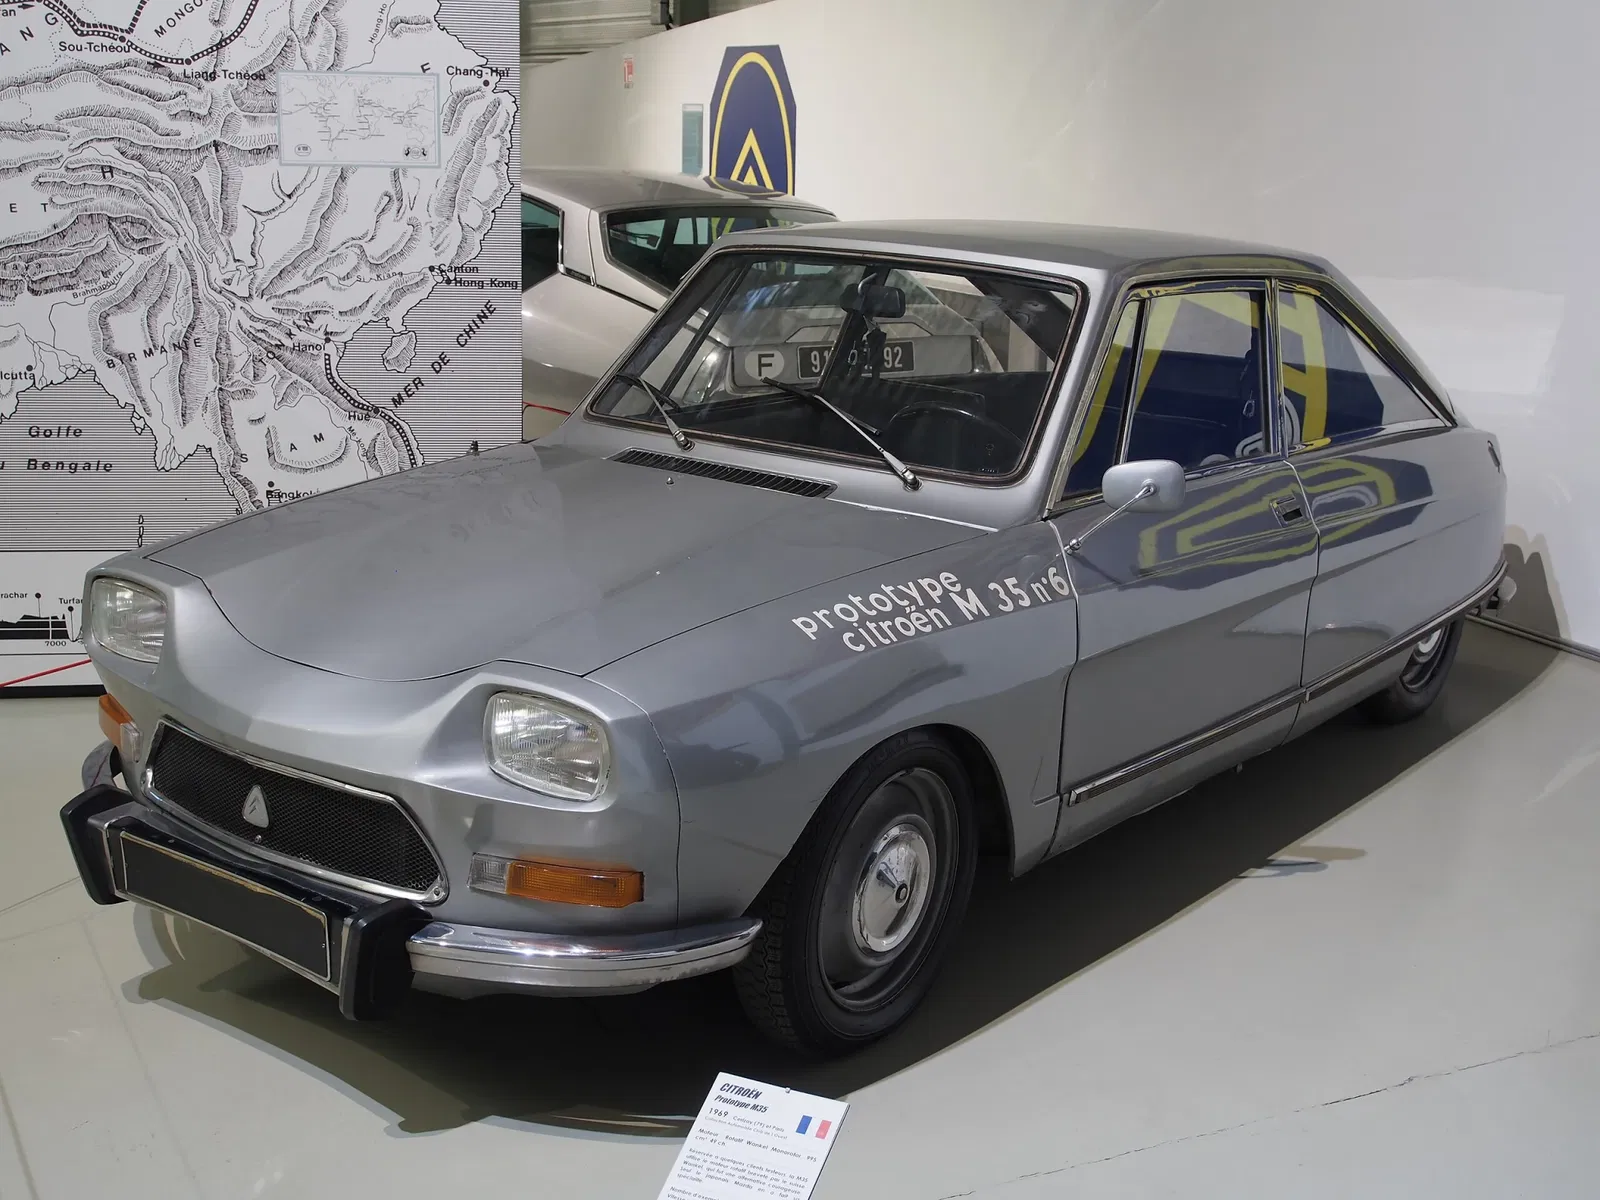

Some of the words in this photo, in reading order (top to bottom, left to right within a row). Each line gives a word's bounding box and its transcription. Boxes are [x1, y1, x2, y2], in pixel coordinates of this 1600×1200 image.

[368, 3, 387, 43] Hoang-Ho
[59, 41, 130, 53] Sou-Tchéou
[439, 264, 479, 273] Canton
[454, 278, 518, 290] Hong-Kong
[391, 377, 424, 408] MER
[431, 351, 450, 374] DE
[456, 299, 496, 348] CHINE
[883, 346, 903, 368] 92
[758, 353, 775, 377] F
[28, 425, 83, 438] Golfe
[27, 458, 113, 473] Bengale
[791, 571, 962, 640] prototype
[842, 607, 952, 652] citroën
[949, 588, 989, 620] M
[988, 577, 1031, 612] 35
[720, 1083, 763, 1100] CITROËN
[715, 1095, 751, 1109] Prototype
[751, 1104, 768, 1113] M35
[708, 1108, 729, 1118] 1969
